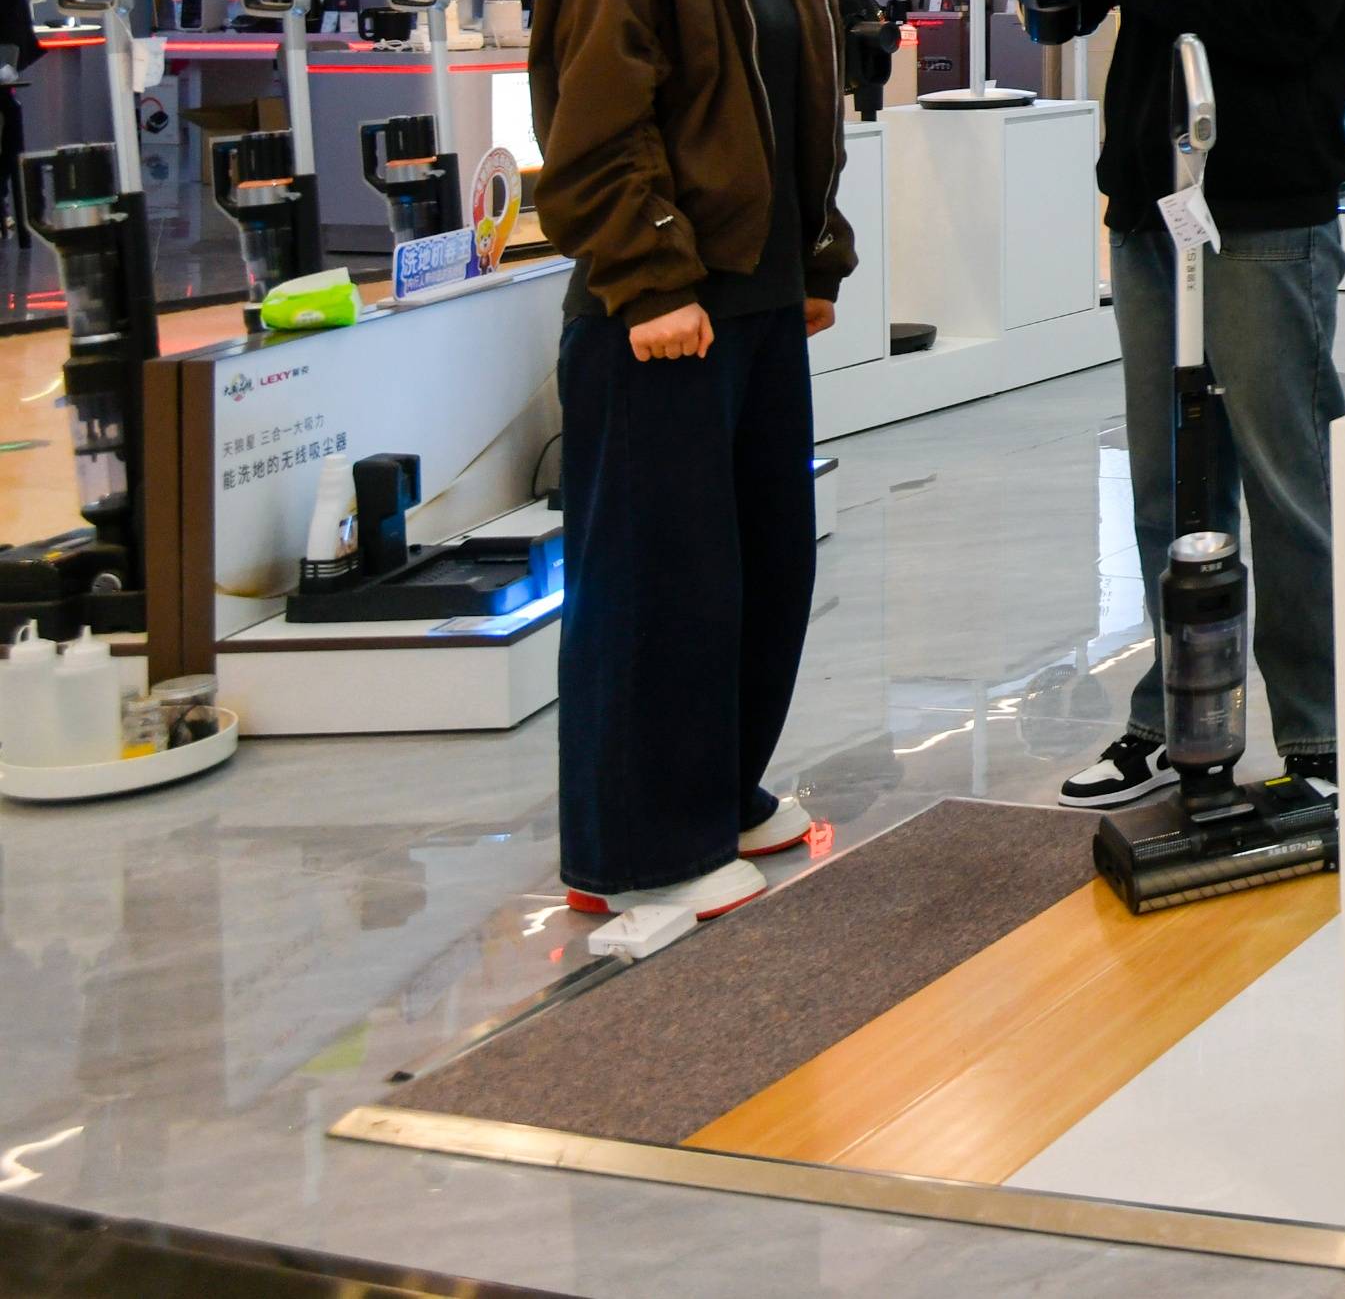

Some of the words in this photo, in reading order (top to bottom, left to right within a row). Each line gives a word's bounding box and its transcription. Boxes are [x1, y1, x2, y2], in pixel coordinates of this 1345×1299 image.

[260, 370, 292, 386] LEXY
[223, 431, 348, 490] 能洗地的无线吸尘器
